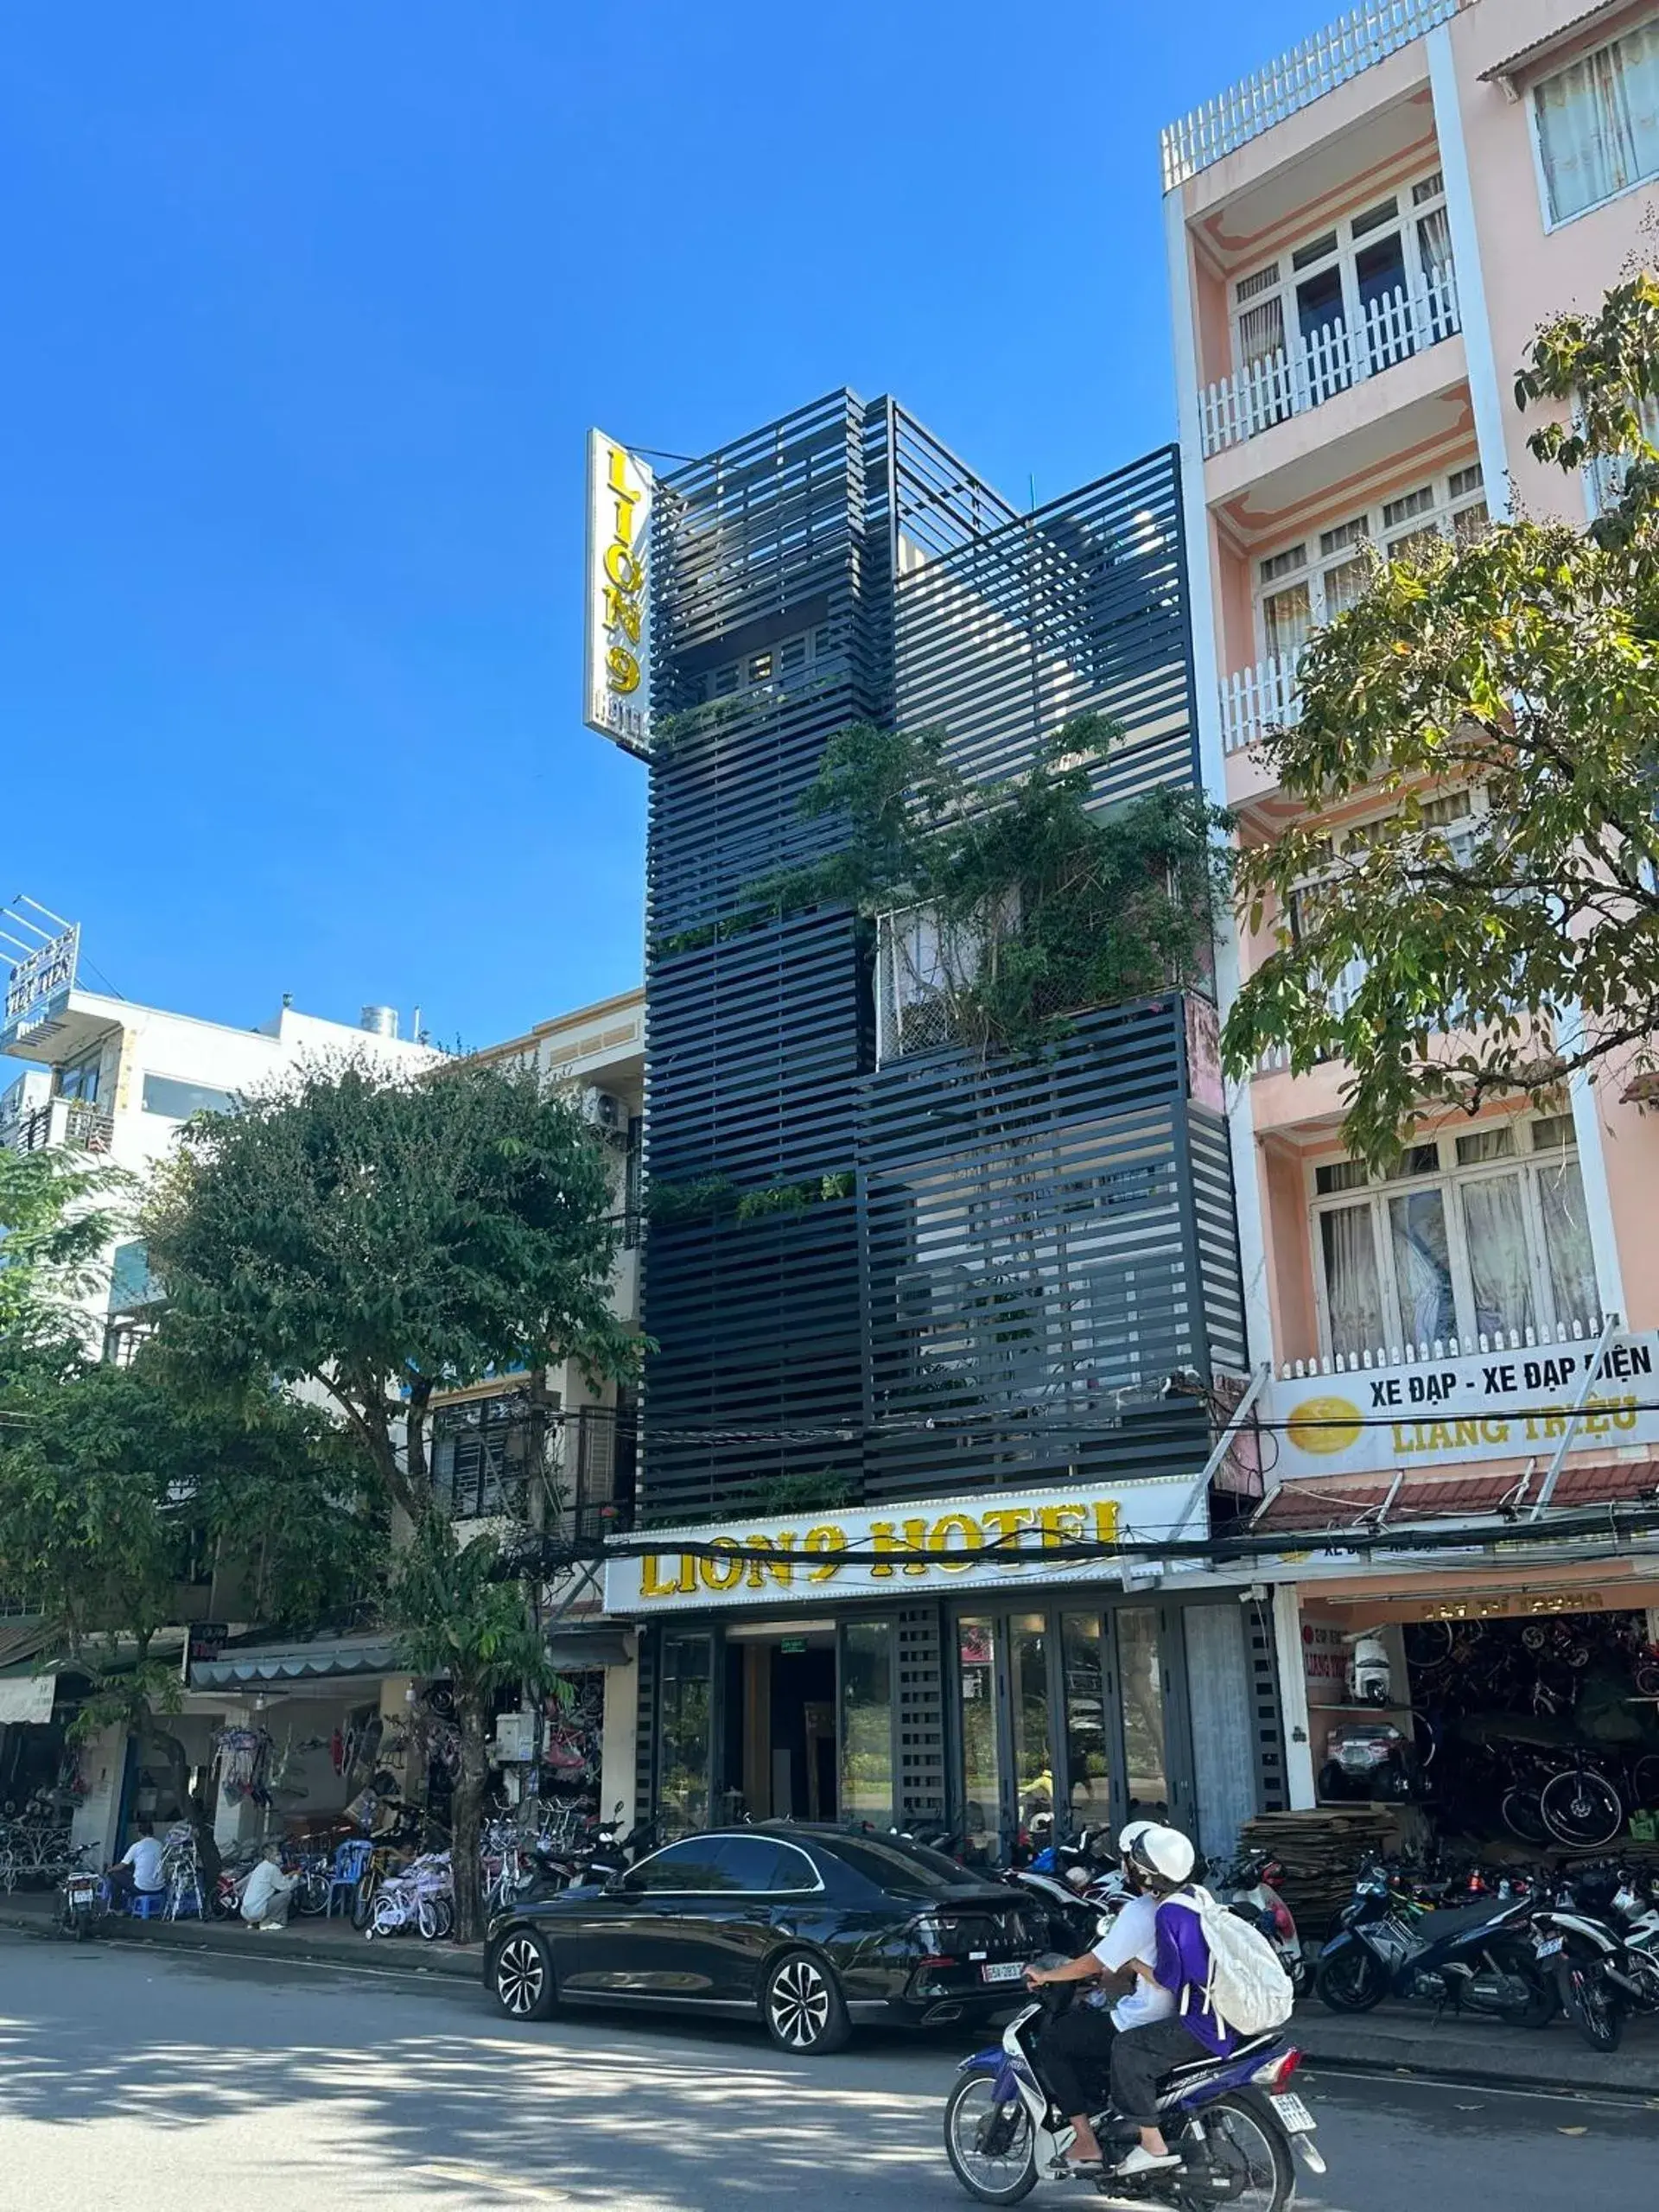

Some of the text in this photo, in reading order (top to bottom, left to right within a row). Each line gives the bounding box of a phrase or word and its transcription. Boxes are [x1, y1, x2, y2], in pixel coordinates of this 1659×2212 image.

[1371, 1380, 1402, 1408] XE
[1409, 1372, 1457, 1406] ĐẠP
[1482, 1364, 1518, 1395] XE
[1524, 1357, 1576, 1392] ĐẠP
[1392, 1392, 1637, 1453] LIANG TRỆU
[869, 1500, 1122, 1578] HOTEL
